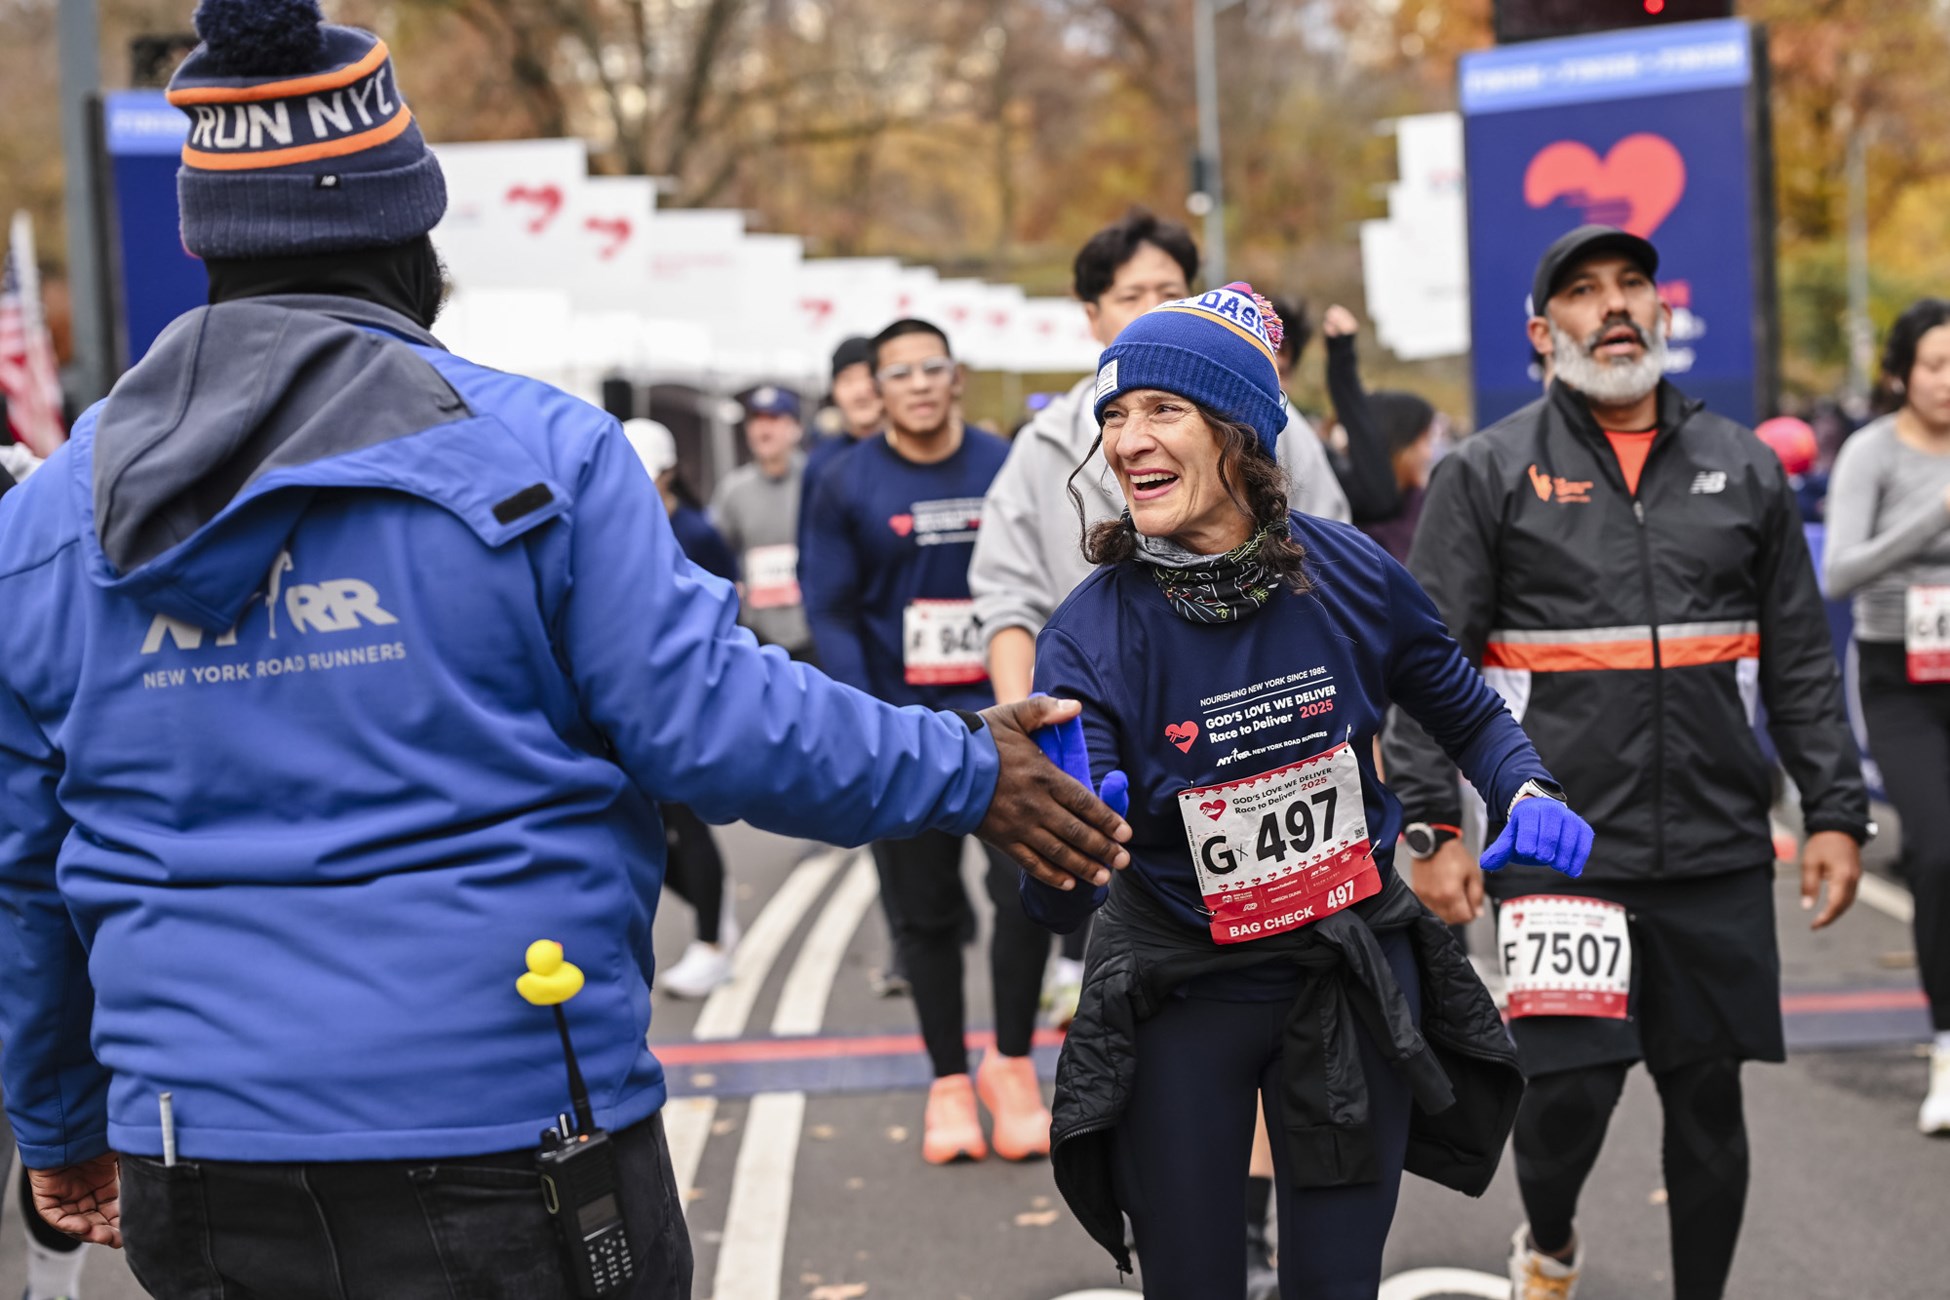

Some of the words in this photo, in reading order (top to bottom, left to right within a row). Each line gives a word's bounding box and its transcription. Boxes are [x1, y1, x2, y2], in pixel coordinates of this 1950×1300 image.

[192, 101, 293, 148] RUN
[307, 67, 394, 139] NYC
[143, 669, 186, 689] NEW
[192, 663, 251, 683] YORK
[256, 657, 306, 678] ROAD
[308, 642, 406, 671] RUNNERS
[1200, 688, 1247, 706] NOURISHING
[1248, 683, 1263, 694] NEW
[1264, 676, 1285, 688] YORK
[1286, 671, 1308, 683] SINCE
[1309, 666, 1327, 677] 1985.
[1206, 711, 1242, 729] GOD'S
[1244, 702, 1271, 719] LOVE
[1273, 697, 1293, 710] WE
[1295, 685, 1336, 705] DELIVER
[1209, 728, 1238, 743] Race
[1240, 726, 1252, 736] to
[1253, 713, 1293, 731] Deliver
[1299, 699, 1334, 719] 2025
[1267, 742, 1283, 751] YORK
[1284, 738, 1301, 747] ROAD
[1302, 731, 1328, 742] RUNNERS
[1232, 795, 1260, 805] GOD'S
[1262, 786, 1282, 798] LOVE
[1284, 780, 1298, 789] WE
[1299, 767, 1332, 783] DELIVER
[1235, 805, 1256, 814] Race
[1258, 801, 1267, 810] to
[1268, 789, 1296, 806] Deliver
[1300, 776, 1327, 791] 2025
[1201, 835, 1238, 875] G
[1256, 786, 1338, 863] 497
[1229, 922, 1261, 938] BAG
[1264, 905, 1315, 930] CHECK
[1327, 880, 1354, 909] 497
[1504, 942, 1517, 976] F
[1527, 933, 1621, 977] 7507
